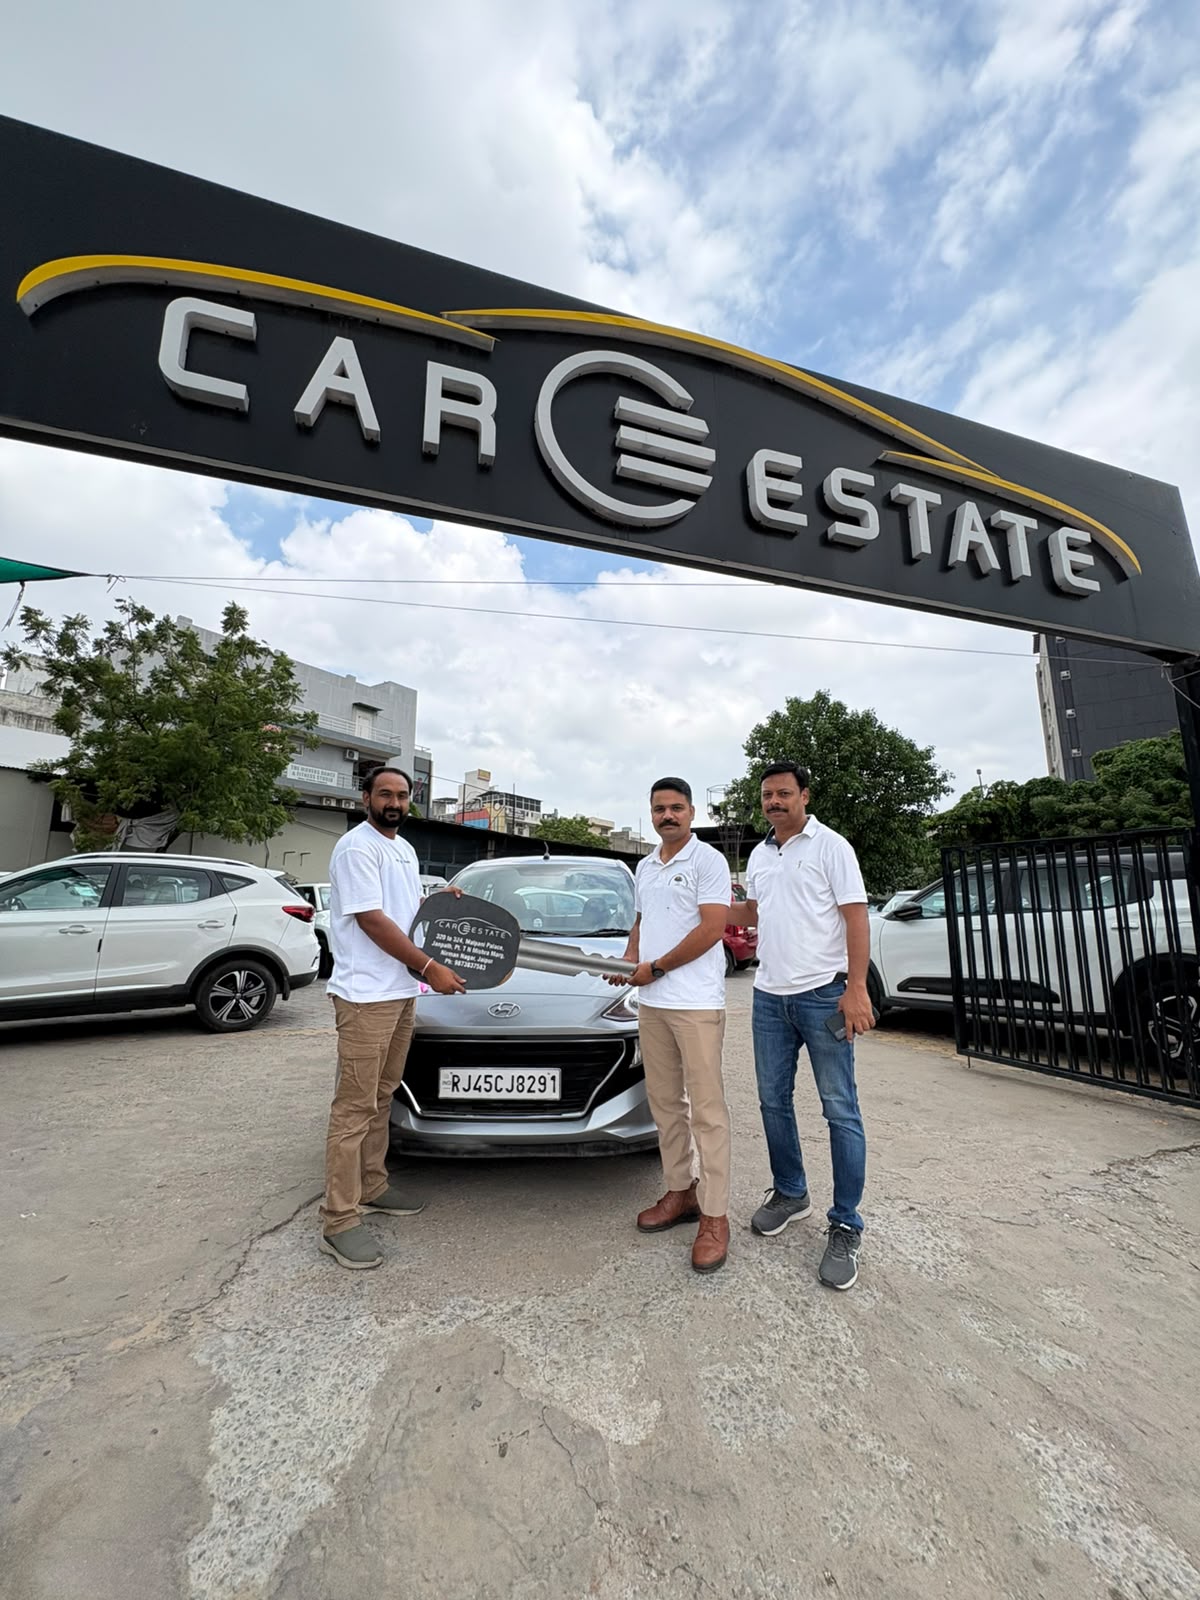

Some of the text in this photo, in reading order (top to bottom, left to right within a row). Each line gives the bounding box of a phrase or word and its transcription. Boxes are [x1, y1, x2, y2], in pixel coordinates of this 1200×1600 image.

[158, 297, 498, 467] CAR
[746, 448, 1101, 597] ESTATE
[438, 921, 457, 929] CAR
[471, 927, 506, 938] ESTATE
[451, 1074, 556, 1094] RJ45CJ8291
